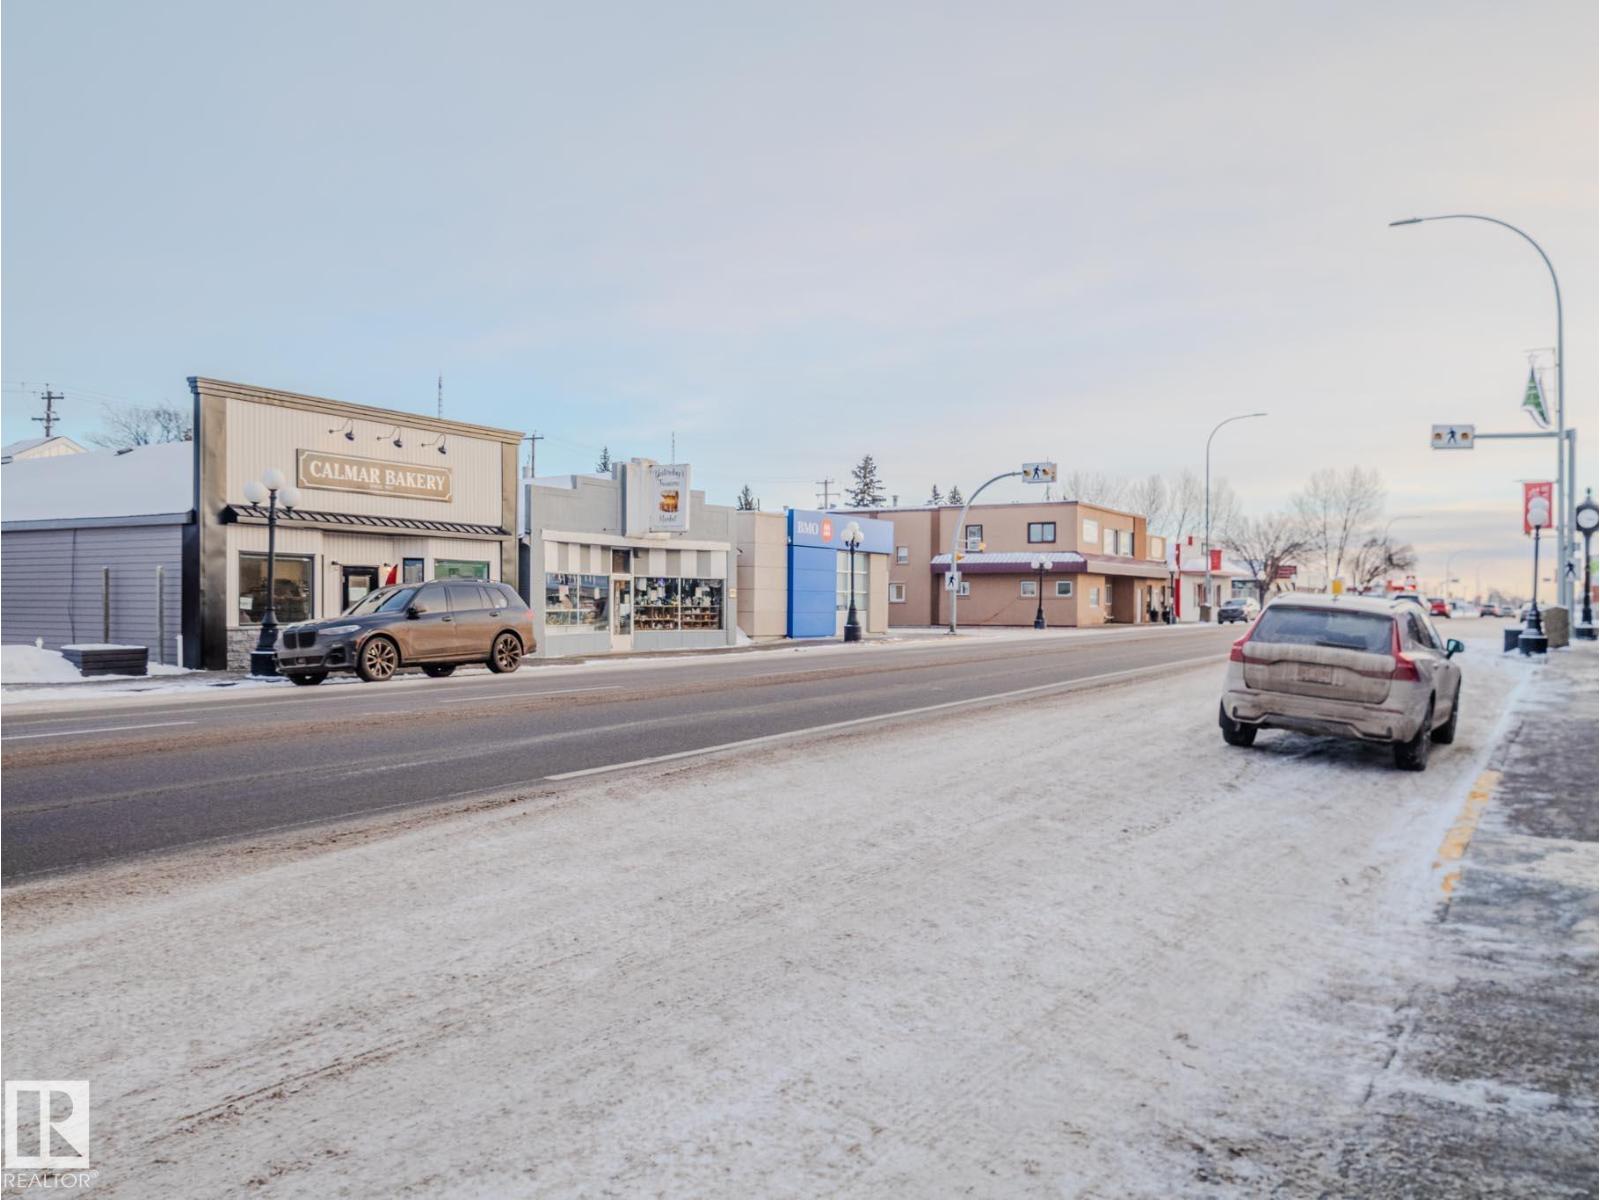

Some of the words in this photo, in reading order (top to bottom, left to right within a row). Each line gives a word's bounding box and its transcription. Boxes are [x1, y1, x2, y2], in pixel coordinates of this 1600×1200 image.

[310, 460, 380, 484] CALMAR
[385, 469, 446, 491] BAKERY
[797, 521, 819, 535] BMO
